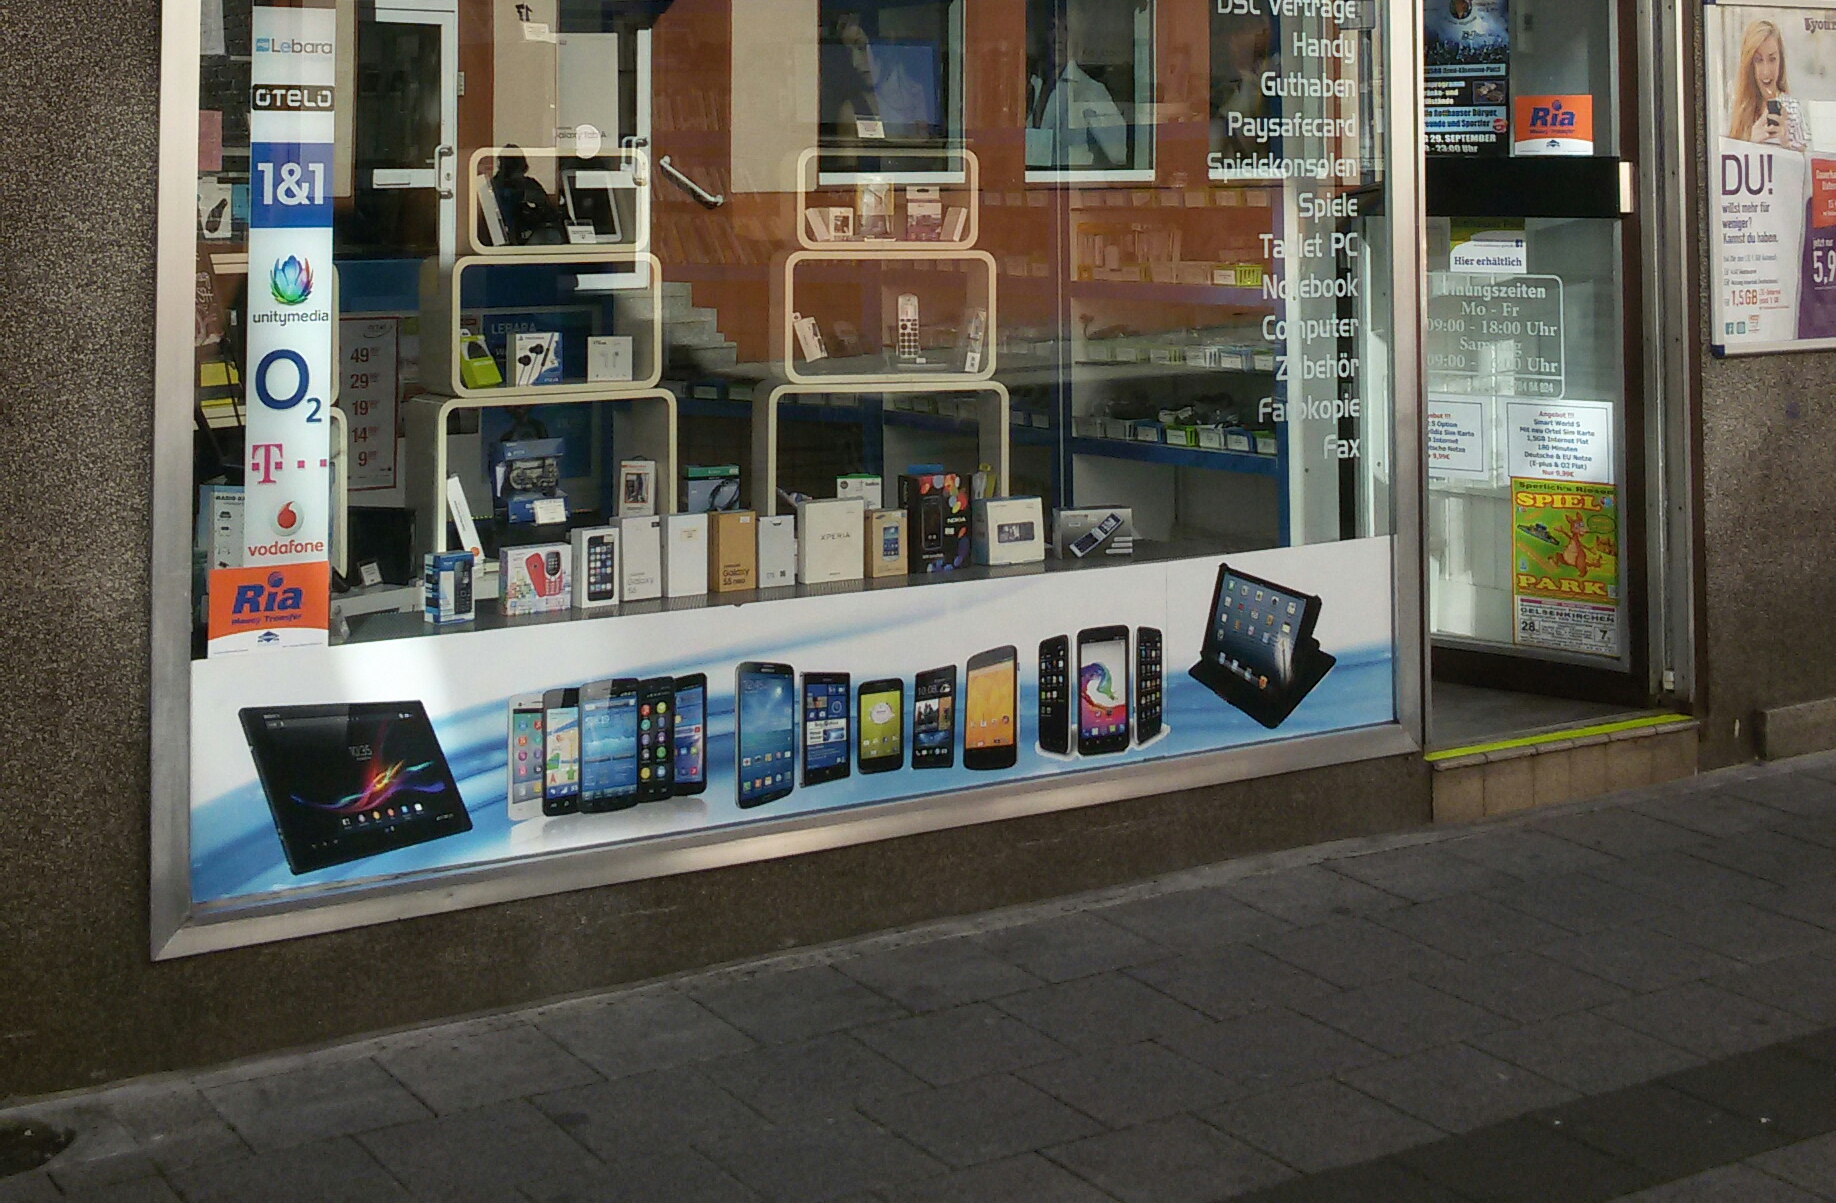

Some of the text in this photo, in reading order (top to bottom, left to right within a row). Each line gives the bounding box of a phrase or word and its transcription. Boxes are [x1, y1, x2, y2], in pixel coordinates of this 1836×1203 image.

[271, 38, 333, 55] Lebara
[1293, 31, 1356, 64] Handy
[1261, 72, 1356, 98] Guthaben
[1529, 99, 1576, 127] Ria
[1227, 111, 1356, 143] Paysafecard
[1207, 152, 1357, 184] Spielekonsolen
[1721, 153, 1773, 196] DU!
[257, 162, 325, 206] 1&1
[1298, 192, 1358, 224] Spiele
[1259, 232, 1358, 259] Talet PC
[1453, 256, 1523, 267] Hier erhältlich
[1262, 273, 1359, 300] Noebook
[252, 309, 330, 327] unitymedia
[1460, 300, 1487, 317] Mo
[1501, 301, 1521, 317] Fr
[1481, 319, 1522, 335] 18:00
[1526, 320, 1558, 337] Uhr
[1275, 352, 1360, 381] Zbehör
[1526, 356, 1559, 374] Uhr
[1323, 434, 1361, 460] Fax
[1547, 436, 1575, 444] Internet
[1524, 451, 1555, 460] Deutsche
[1516, 491, 1602, 512] SPIEL
[247, 539, 324, 558] vodafone
[231, 570, 304, 615] Ria
[1515, 572, 1609, 598] PARK
